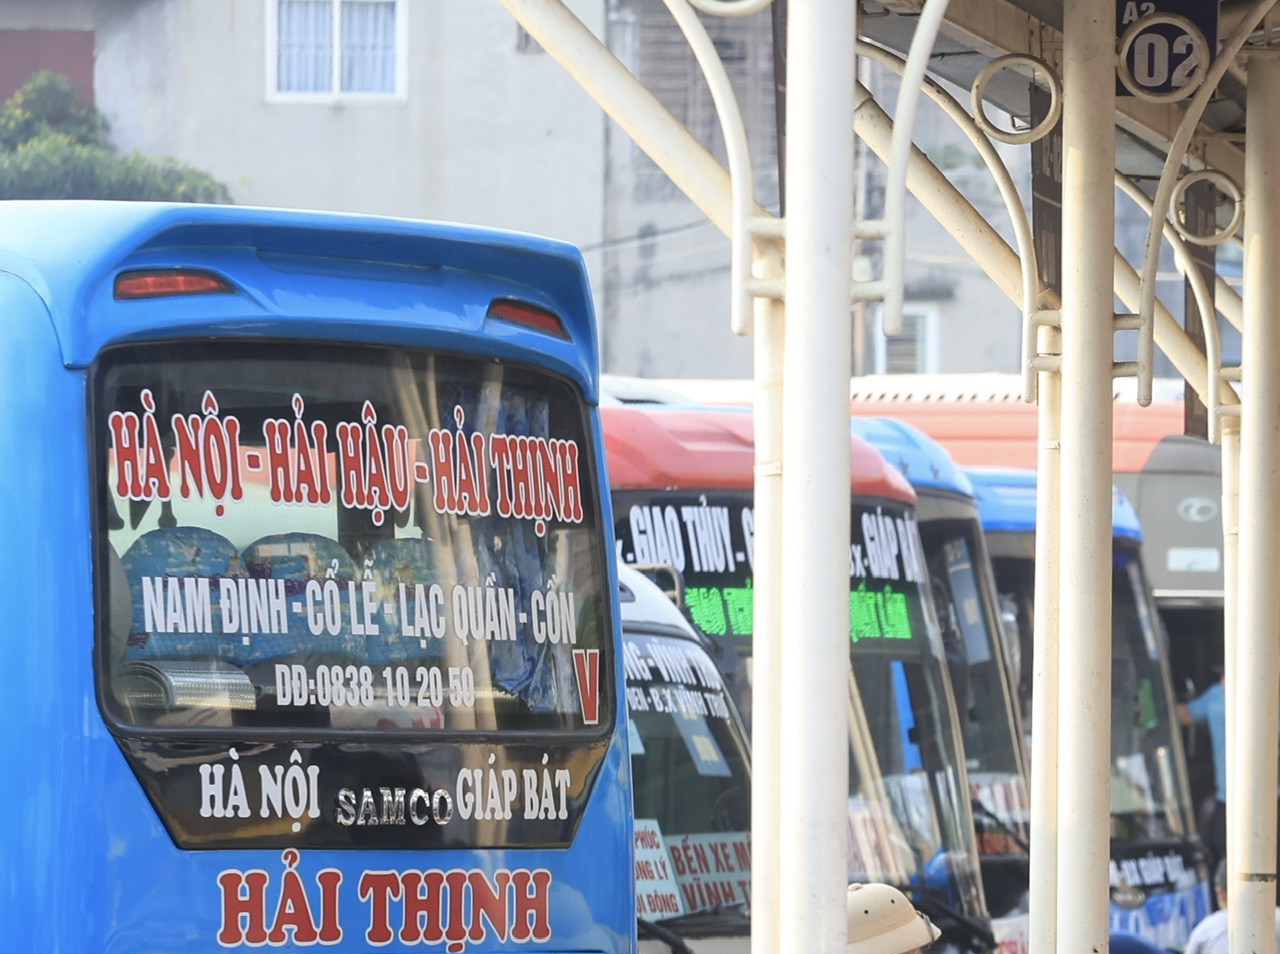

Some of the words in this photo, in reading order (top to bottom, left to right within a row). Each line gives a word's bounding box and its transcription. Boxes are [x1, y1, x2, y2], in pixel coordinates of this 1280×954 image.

[1134, 33, 1201, 87] 02
[108, 388, 171, 502] HÀ
[171, 390, 244, 519] NỘI
[263, 392, 332, 506] HẢI
[336, 400, 410, 526] HẬU
[428, 404, 491, 516] HẢI
[489, 432, 584, 538] THỊNH
[141, 576, 213, 634] NAM
[219, 578, 289, 646] ĐỊNH
[305, 558, 342, 636] CỔ
[348, 558, 380, 636] LỄ
[398, 582, 446, 648] LẠC
[452, 572, 517, 646] QUẦN
[530, 574, 577, 645] CỒN
[274, 663, 374, 707] DĐ:0838
[382, 666, 410, 707] 10
[416, 666, 443, 707] 20
[448, 666, 475, 707] 50
[571, 649, 600, 725] V
[199, 747, 251, 818] HÀ
[258, 749, 321, 832] NỘI
[334, 786, 454, 826] SAMCO
[456, 753, 518, 820] GIÁP
[522, 753, 571, 820] BÁT
[669, 834, 711, 876] BẾN
[708, 842, 735, 873] XE
[216, 848, 344, 948] HẢI
[358, 868, 552, 953] THỊNH
[682, 877, 736, 911] VĨNH
